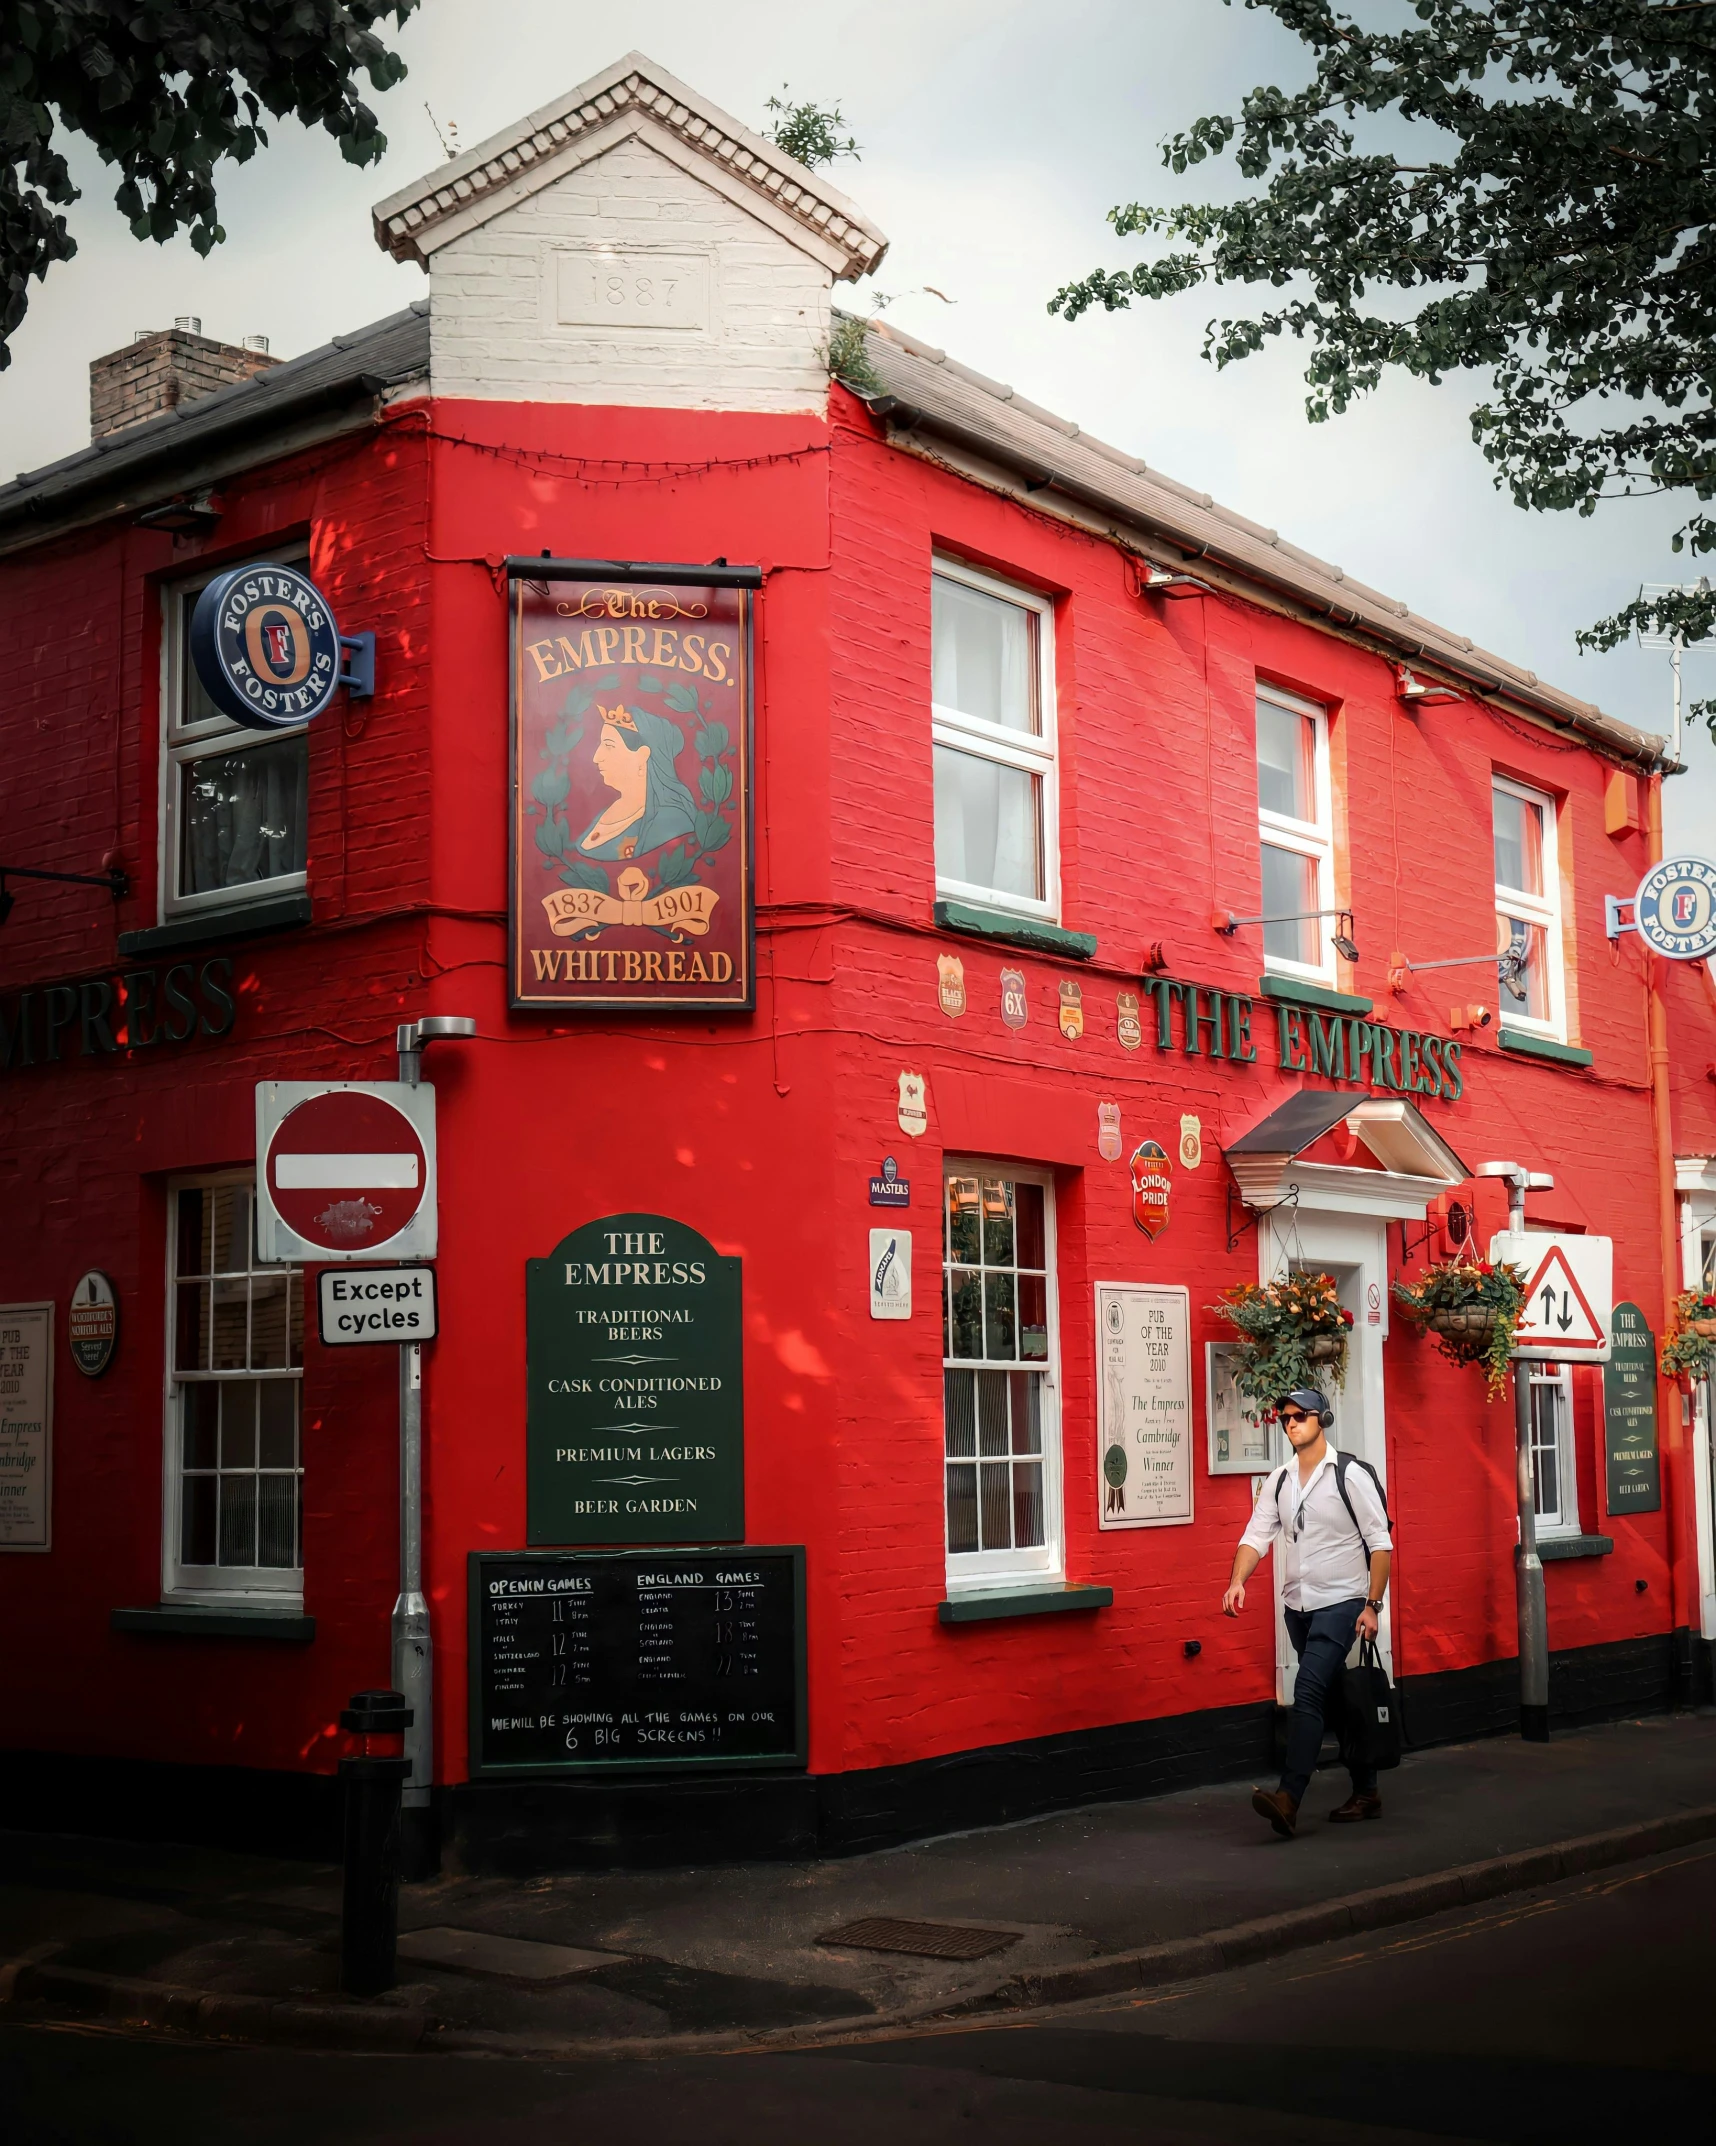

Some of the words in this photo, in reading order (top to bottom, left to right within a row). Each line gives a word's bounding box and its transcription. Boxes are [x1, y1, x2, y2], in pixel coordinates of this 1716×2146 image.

[584, 276, 679, 306] 1887
[224, 576, 326, 634] FOSTER'S
[602, 588, 662, 619] The
[231, 652, 331, 712] FOSTER'S
[549, 893, 606, 918] 1837
[653, 891, 704, 920] 1901
[530, 949, 734, 983] WHITBREAD
[1005, 991, 1024, 1017] 6X
[1144, 977, 1258, 1063] THE
[1278, 1004, 1463, 1101] EMPRESS
[1132, 1173, 1172, 1195] LONDON
[1142, 1191, 1169, 1206] PRIDE
[603, 1232, 666, 1255] THE
[564, 1262, 706, 1286] EMPRESS
[331, 1278, 423, 1302] Except
[337, 1308, 420, 1335] cycles
[575, 1309, 694, 1324] TRADITIONAL
[1148, 1310, 1165, 1323] PUB
[1619, 1313, 1636, 1328] THE
[2, 1330, 21, 1344] PUB
[608, 1327, 663, 1341] BEERS
[1141, 1326, 1152, 1339] OF
[1156, 1326, 1173, 1340] THE
[1611, 1332, 1647, 1347] EMPRESS
[10, 1346, 30, 1360] THE
[1146, 1342, 1169, 1356] YEAR
[1149, 1359, 1166, 1372] 2010
[0, 1380, 20, 1394] 2010
[548, 1379, 592, 1393] CASK
[598, 1377, 722, 1392] CONDITIONED
[614, 1395, 658, 1409] ALES
[1131, 1396, 1147, 1410] The
[1152, 1396, 1185, 1417] Empress
[1, 1418, 41, 1440] Empress
[1136, 1428, 1181, 1448] Cambridge
[556, 1448, 642, 1462] PREMIUM
[650, 1446, 716, 1460] LAGERS
[1143, 1457, 1174, 1471] Winner
[574, 1500, 619, 1514] BEER
[625, 1499, 697, 1513] GARDEN
[547, 1577, 592, 1592] GAMES
[637, 1572, 704, 1586] ENGLAND
[715, 1572, 760, 1584] GAMES
[714, 1591, 733, 1612] 13
[715, 1621, 733, 1644] 18
[552, 1633, 566, 1656] 12
[551, 1663, 566, 1686] 12
[539, 1715, 556, 1729] BE
[562, 1713, 613, 1725] SHOWING
[621, 1713, 640, 1724] ALL
[644, 1711, 670, 1724] THE
[679, 1711, 718, 1723] GAMES
[728, 1712, 745, 1722] ON
[751, 1711, 776, 1723] OUR
[565, 1727, 578, 1750] 6
[594, 1728, 621, 1746] BIG
